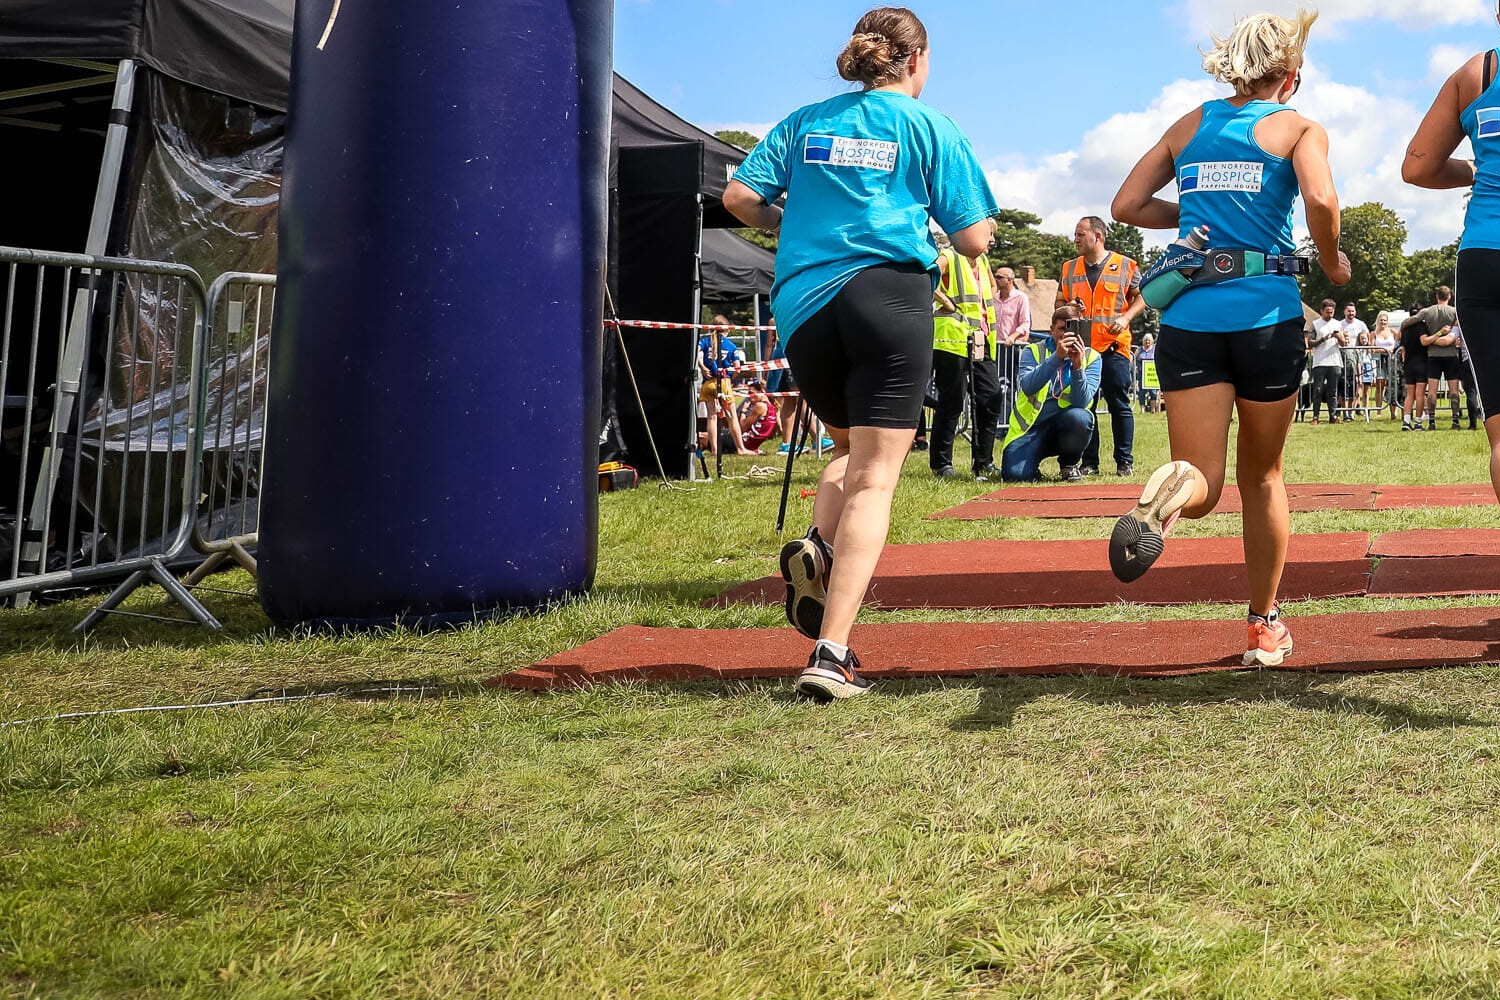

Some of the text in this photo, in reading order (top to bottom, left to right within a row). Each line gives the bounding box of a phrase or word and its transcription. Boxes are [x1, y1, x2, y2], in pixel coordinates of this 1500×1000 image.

[856, 140, 895, 150] NORFOLK
[834, 146, 895, 162] HOSPICE
[866, 161, 893, 169] HOUSE
[1221, 163, 1260, 171] NORFOLK
[1201, 171, 1260, 183] HOSPICE
